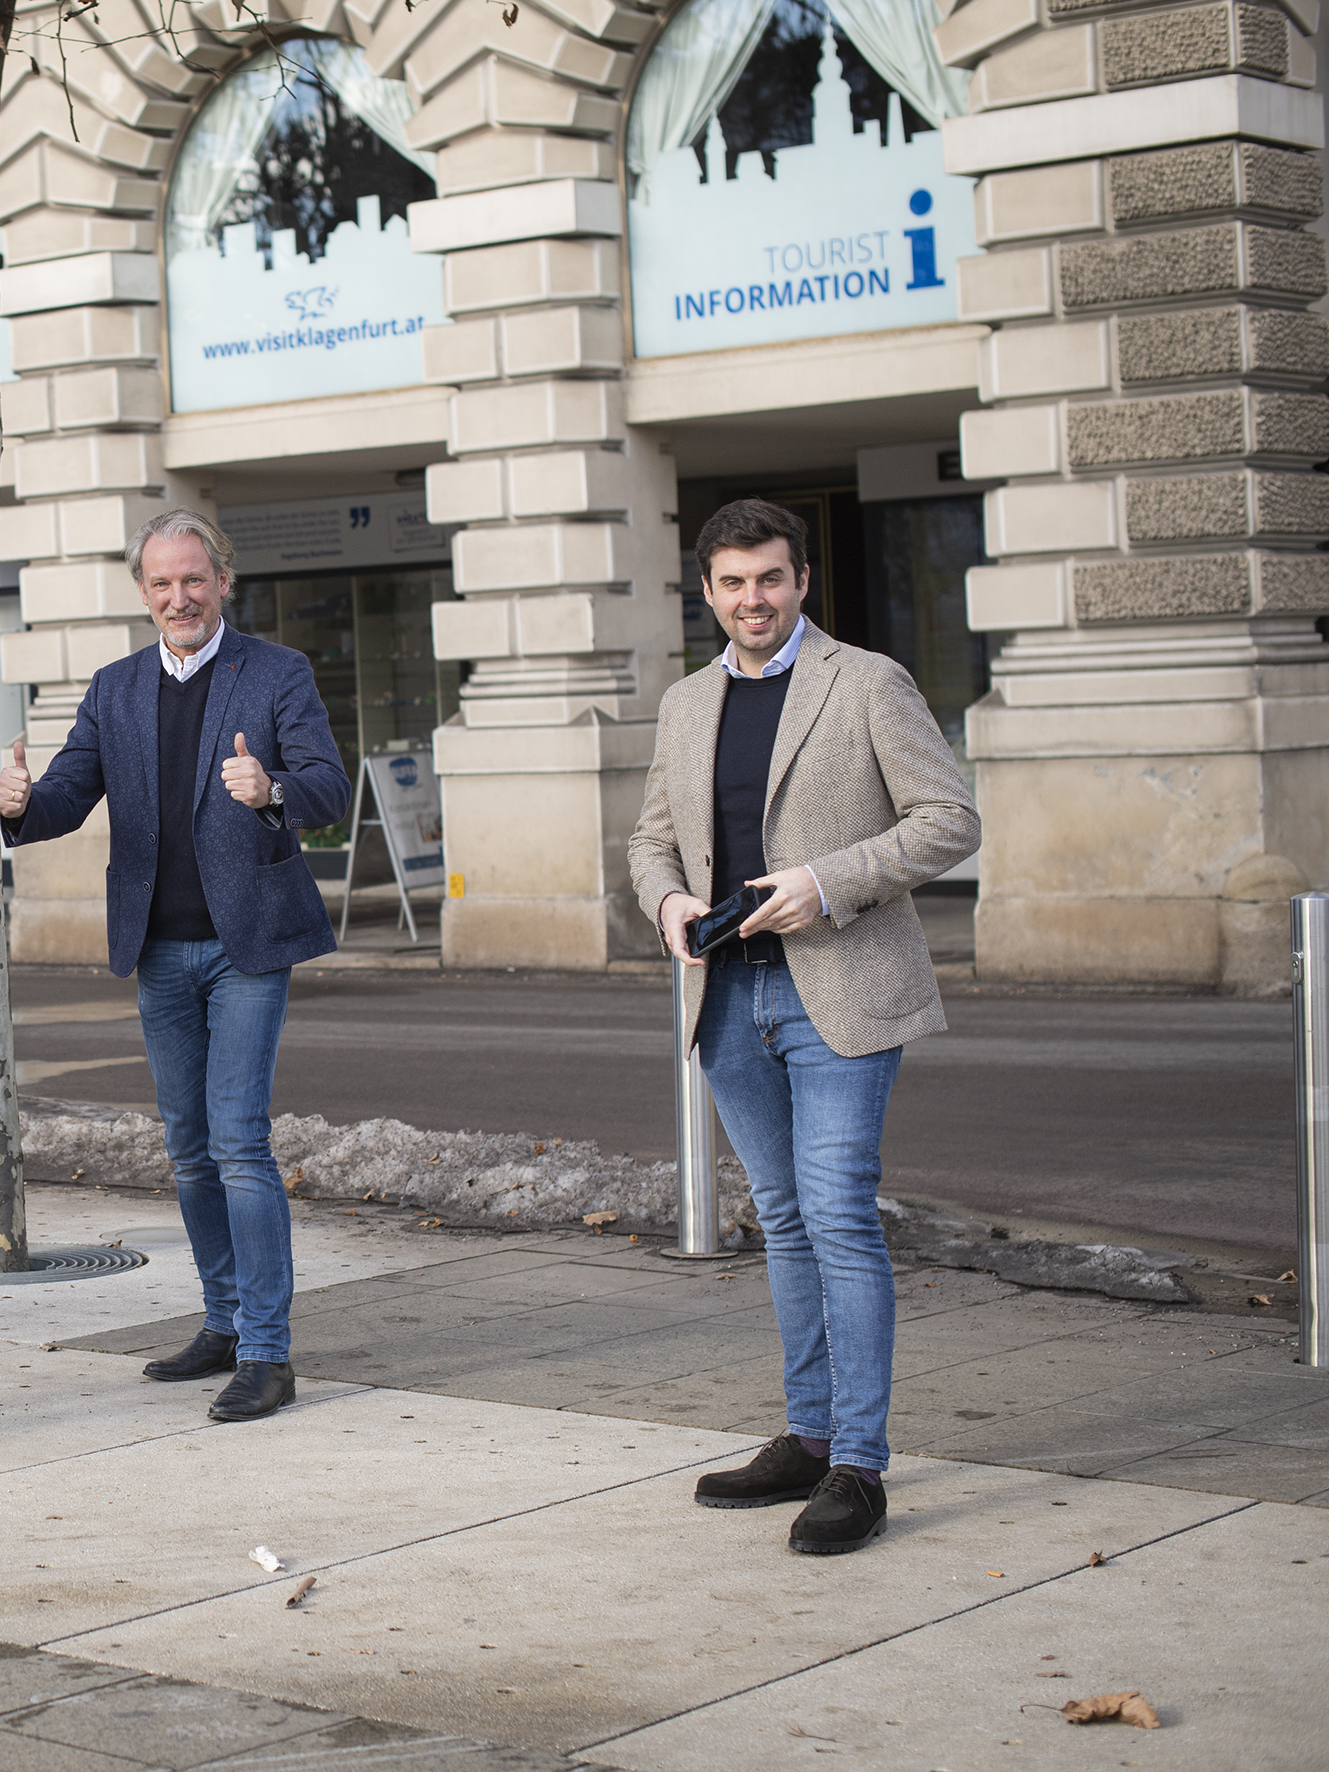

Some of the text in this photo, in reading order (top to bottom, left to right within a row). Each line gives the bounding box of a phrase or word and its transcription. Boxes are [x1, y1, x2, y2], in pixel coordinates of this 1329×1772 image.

[763, 229, 891, 275] TOURIST
[674, 267, 891, 321] INFORMATION
[201, 315, 425, 360] www.visitklagenfurt.at
